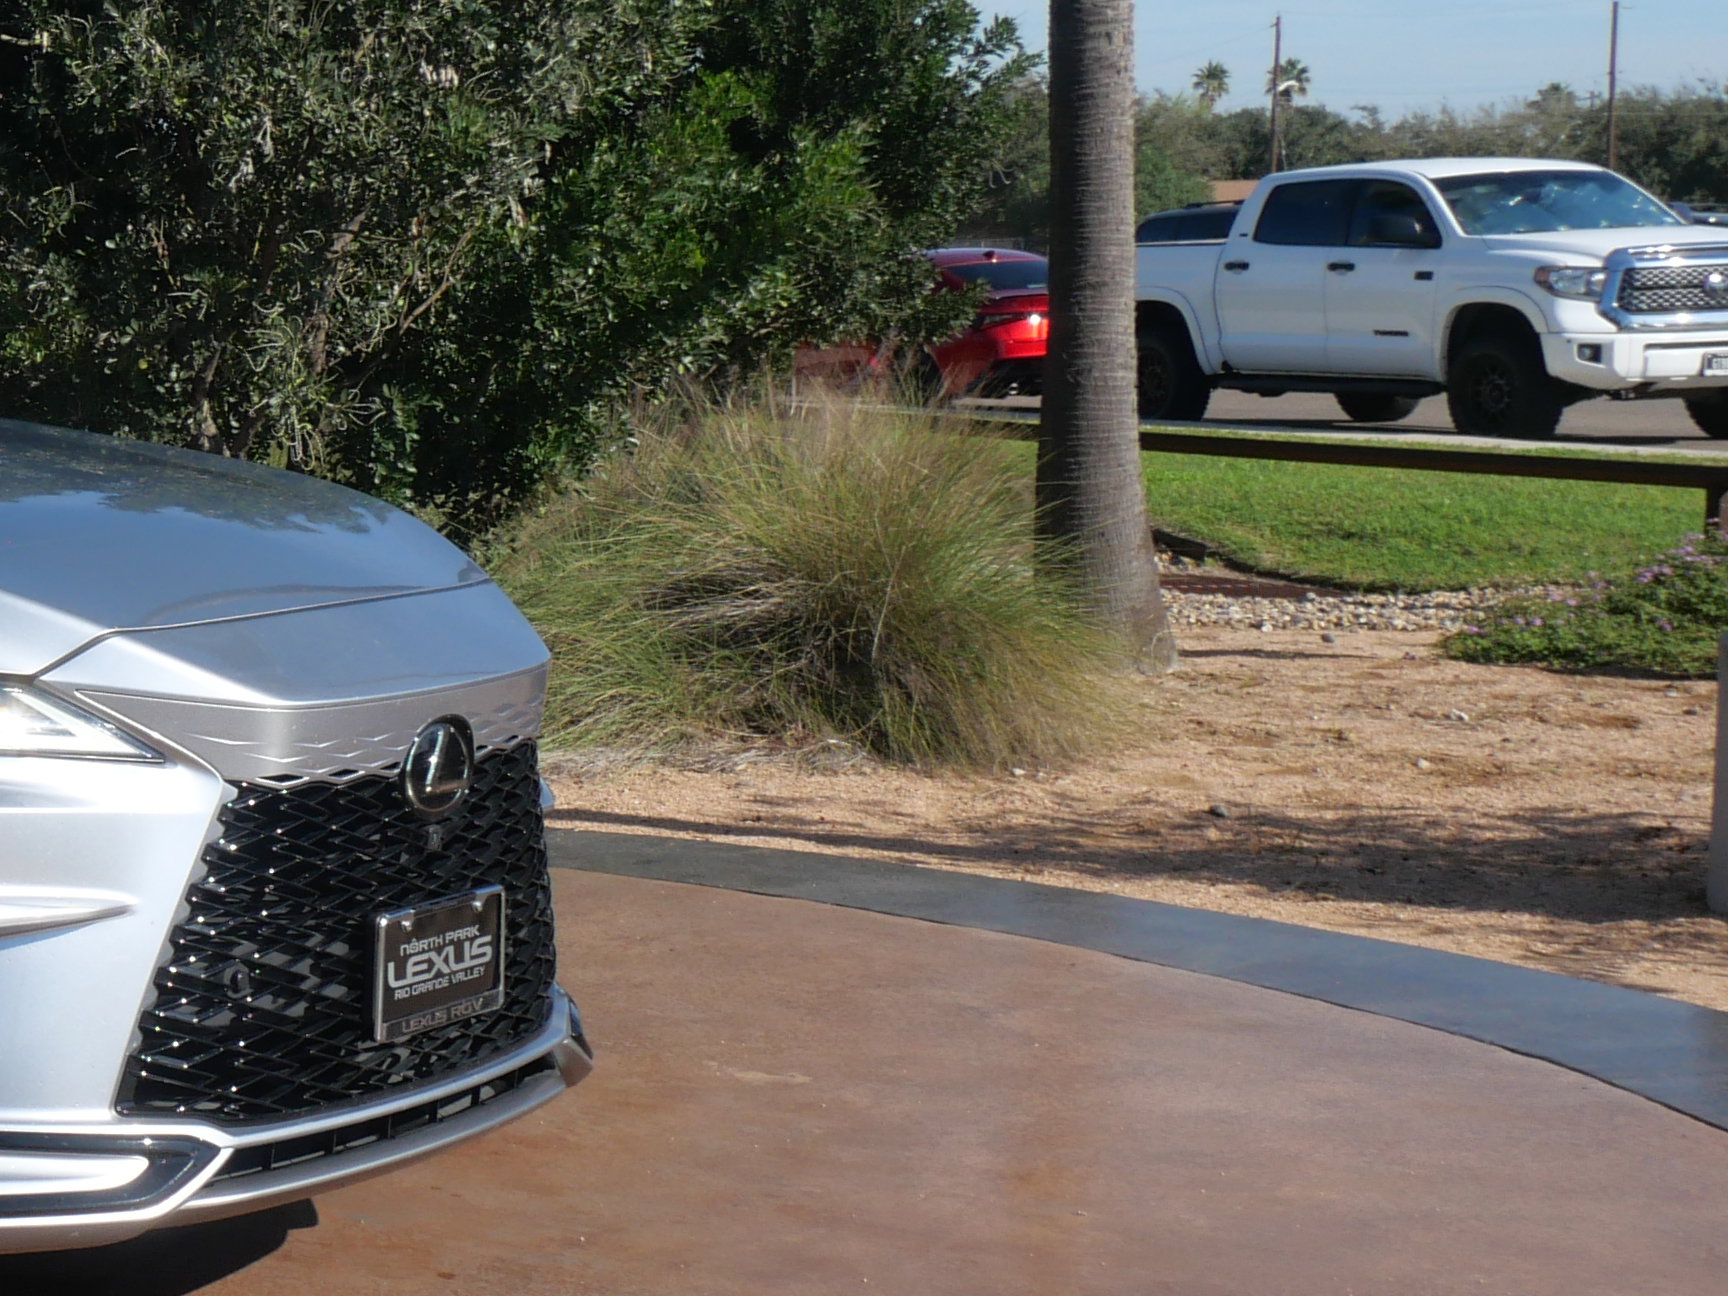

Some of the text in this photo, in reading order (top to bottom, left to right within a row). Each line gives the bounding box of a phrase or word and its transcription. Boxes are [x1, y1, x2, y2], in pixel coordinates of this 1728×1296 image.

[445, 924, 480, 944] PARK
[387, 934, 493, 989] LEXUS
[394, 965, 486, 1001] RIO GRANDE VALLEY
[402, 997, 484, 1033] LEXUS RGV
